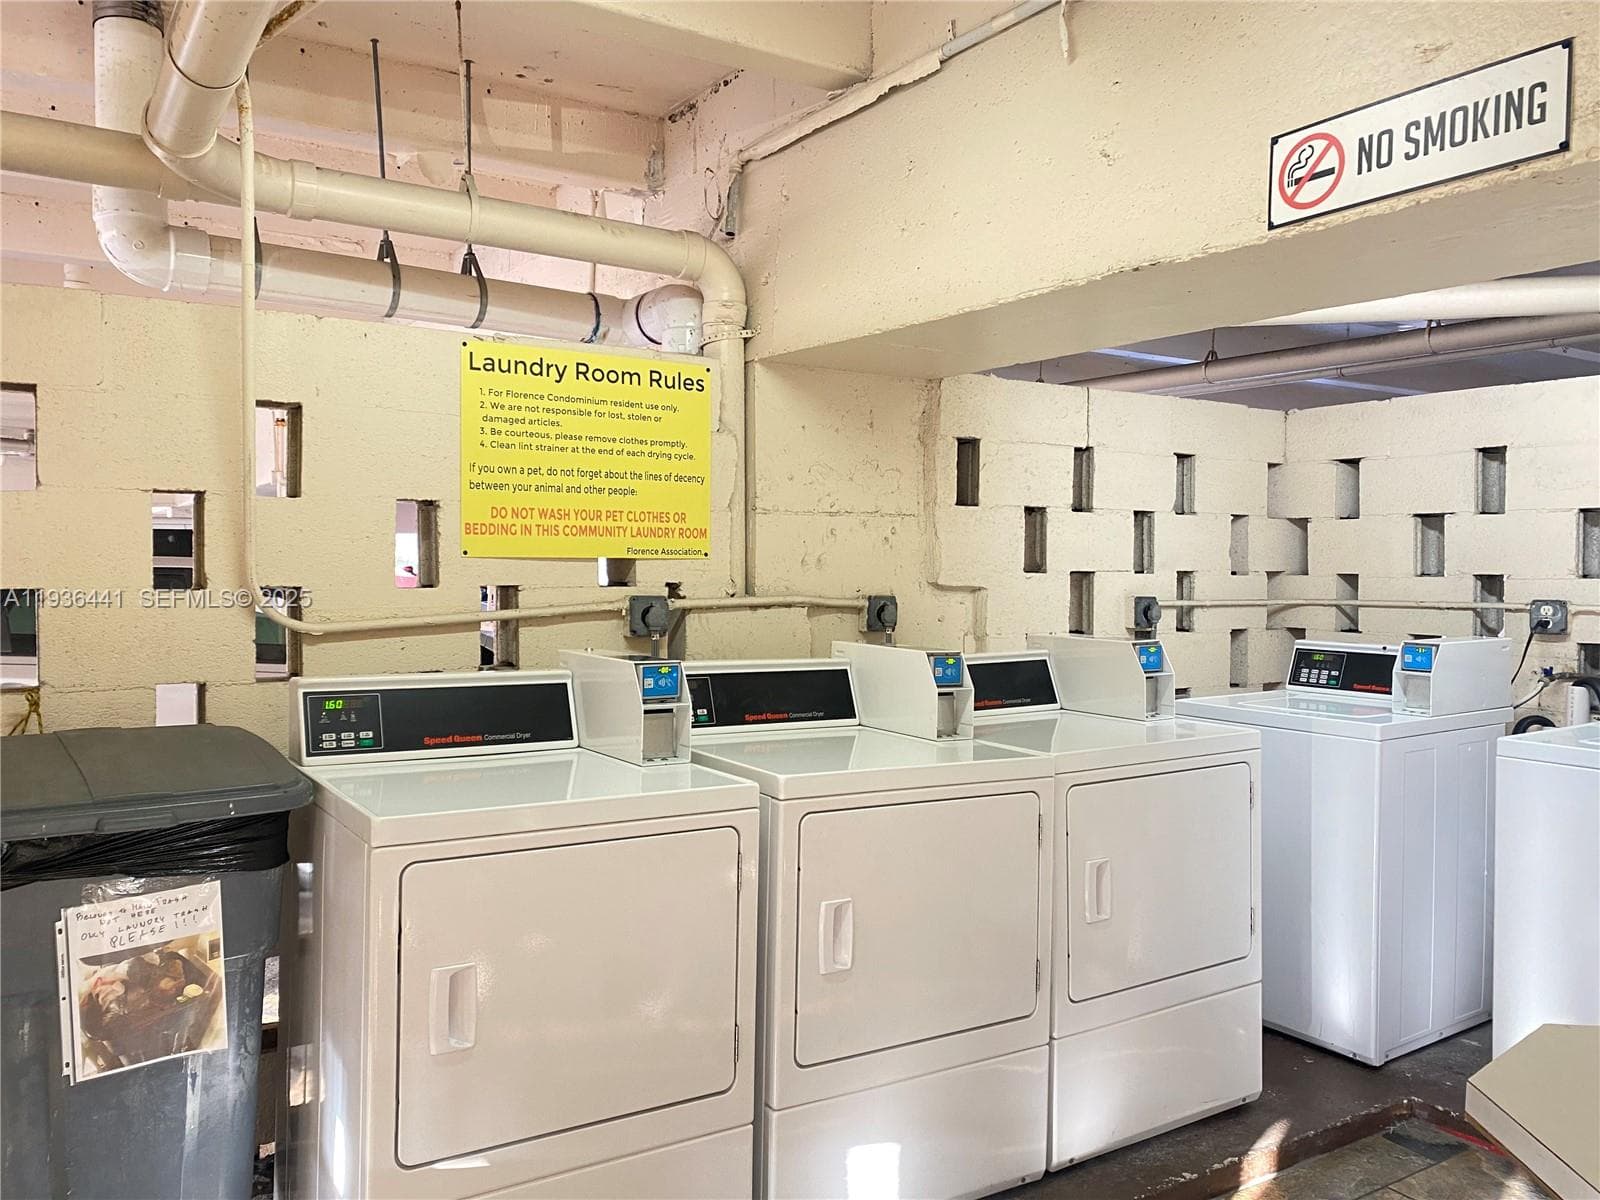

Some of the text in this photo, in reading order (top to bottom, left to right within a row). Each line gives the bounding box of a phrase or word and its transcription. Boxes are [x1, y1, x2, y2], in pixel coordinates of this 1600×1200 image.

[1357, 81, 1548, 175] NO SMOKING
[469, 351, 705, 392] Laundry Room Rules
[479, 387, 486, 396] 1.
[488, 388, 503, 397] For
[505, 389, 545, 400] Florence
[547, 393, 608, 405] Condominium
[610, 399, 644, 410] resident
[661, 404, 680, 414] only.
[479, 401, 487, 409] 2.
[490, 402, 505, 410] We
[525, 405, 540, 413] not
[542, 406, 592, 416] responsible
[594, 410, 606, 418] for
[627, 412, 651, 422] stolen
[482, 414, 563, 427] damaged articles.
[479, 427, 487, 435] 3.
[490, 427, 502, 436] Be
[554, 432, 583, 442] please
[585, 435, 617, 443] remove
[618, 436, 648, 446] clothes
[650, 440, 688, 449] promptly.
[479, 440, 696, 461] 4. Clean lint strainer at the end of each drying cycle.
[469, 462, 705, 485] If you own a pet, do not forget about the lines of decency
[469, 480, 509, 491] between
[512, 483, 532, 493] your
[534, 483, 564, 493] animal
[565, 484, 581, 494] and
[583, 484, 606, 494] other
[490, 506, 687, 524] DO NOT WASH YOUR PET CLOTHES OR
[464, 522, 707, 539] BEDDING IN THIS COMMUNITY LAUNDRY ROOM
[626, 547, 659, 555] Florence
[744, 713, 767, 722] Speed
[767, 712, 789, 720] Queen
[423, 732, 532, 746] Speed Queen Commercial Dryer
[118, 916, 165, 933] LAUNDRY
[173, 905, 208, 919] TRASH
[110, 924, 167, 949] PLEASE
